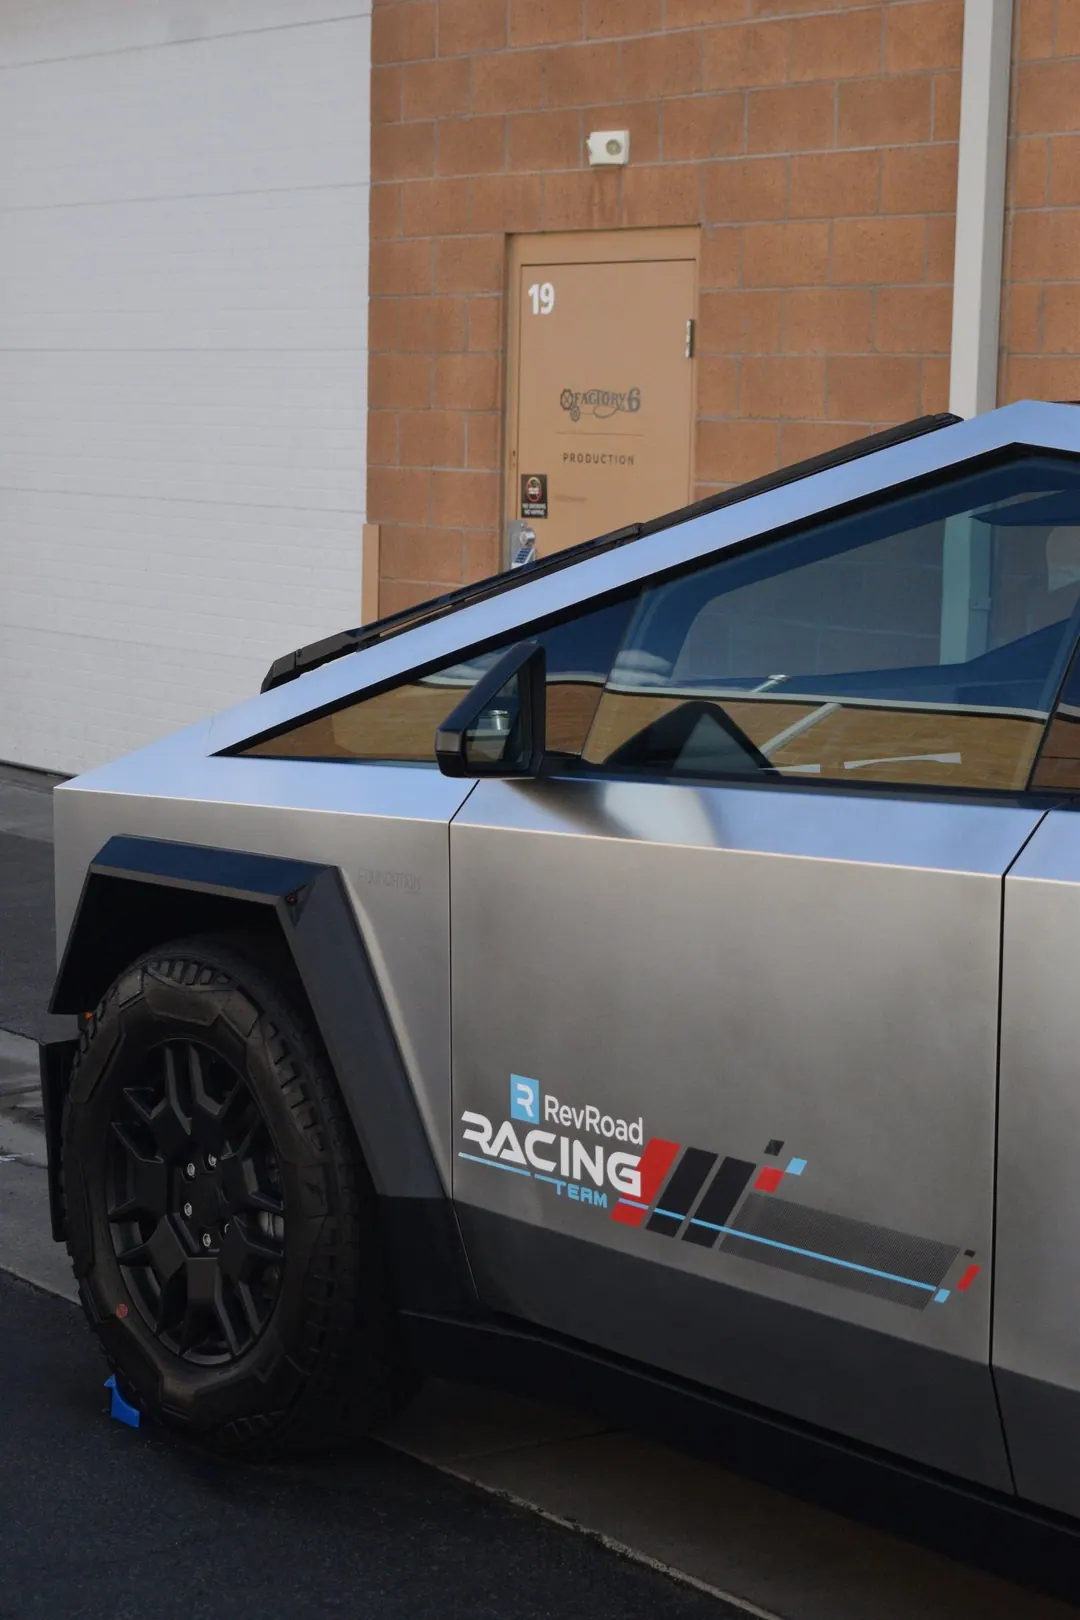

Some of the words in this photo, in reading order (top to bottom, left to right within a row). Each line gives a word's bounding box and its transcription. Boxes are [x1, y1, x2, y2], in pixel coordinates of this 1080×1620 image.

[528, 282, 555, 315] 19
[562, 452, 635, 466] PRODUCTION
[544, 1094, 643, 1145] RevRoad
[461, 1110, 641, 1197] RACING
[554, 1181, 608, 1208] TEAM
